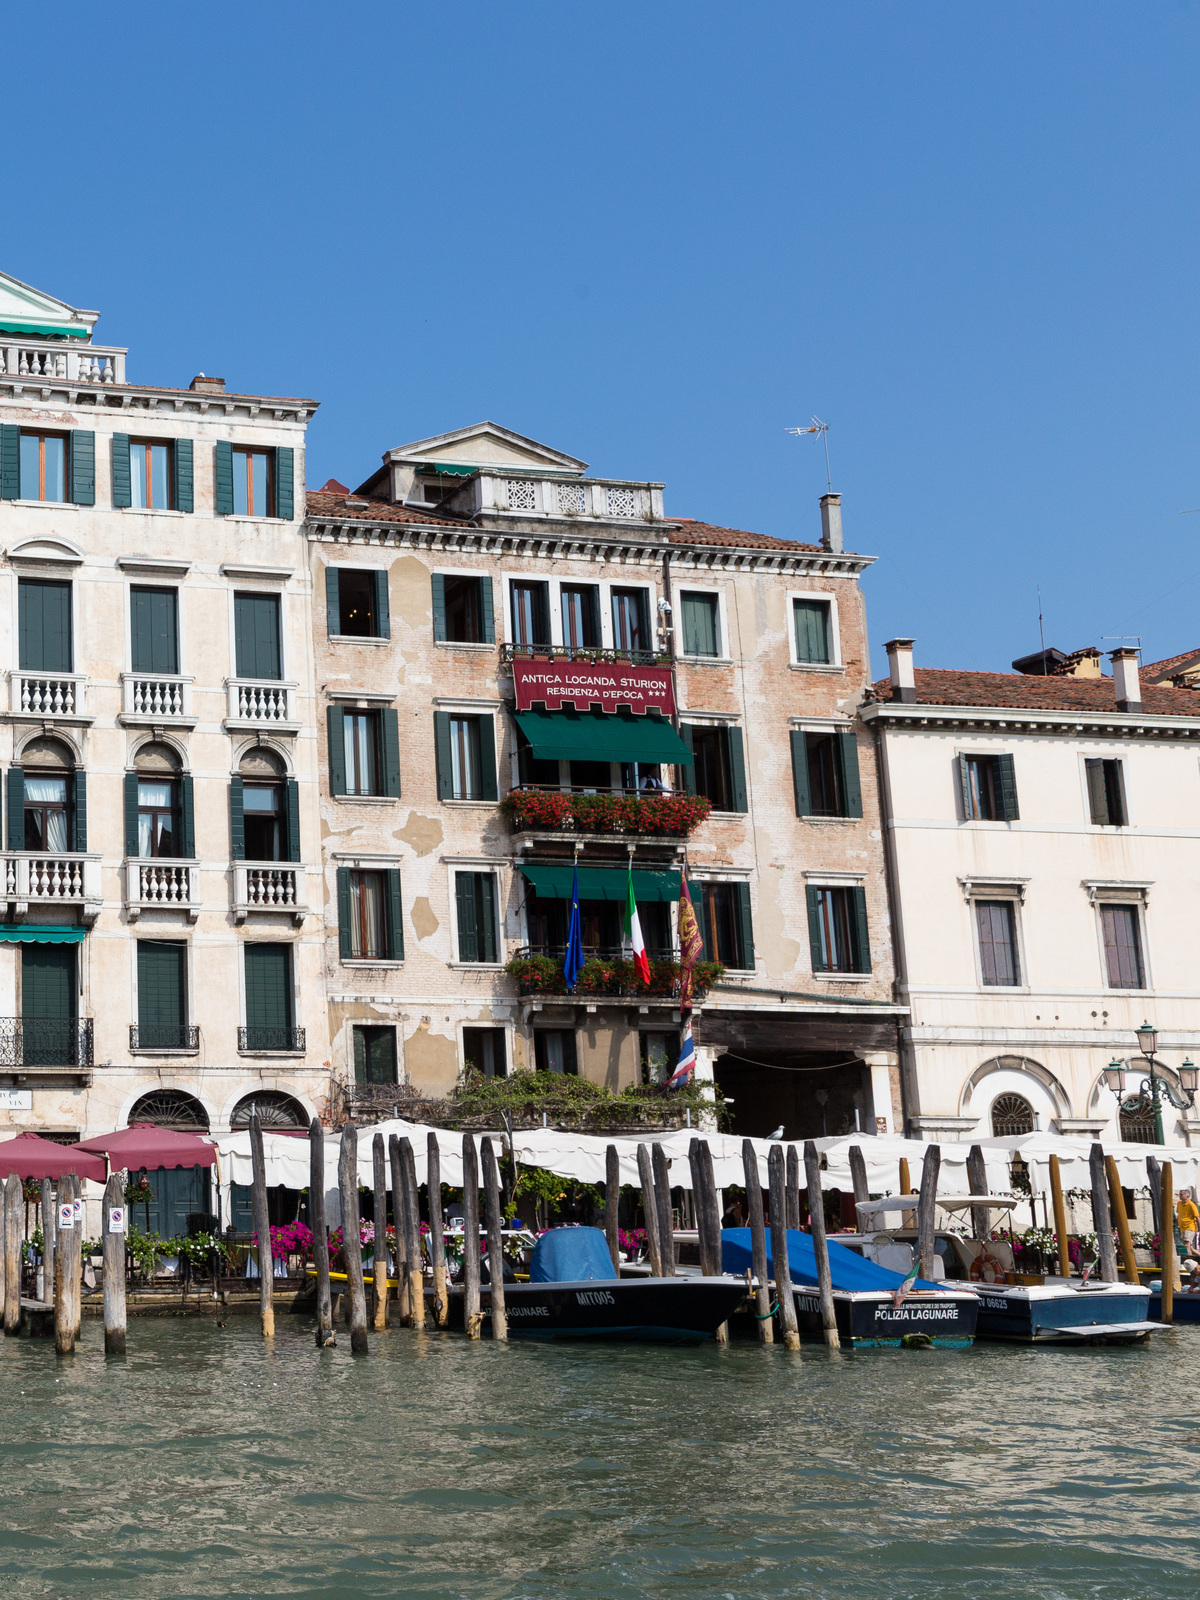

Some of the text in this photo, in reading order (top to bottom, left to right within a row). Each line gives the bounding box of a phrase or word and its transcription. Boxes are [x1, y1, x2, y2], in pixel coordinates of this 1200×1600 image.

[521, 674, 667, 689] ANTICA LOCANDA STURION
[546, 687, 599, 697] RESIDENZA
[576, 1291, 615, 1305] MIT005
[987, 1297, 1008, 1309] 06625
[506, 1306, 550, 1316] AGUNARE
[874, 1309, 959, 1320] POLIZIA LAGUNARE
